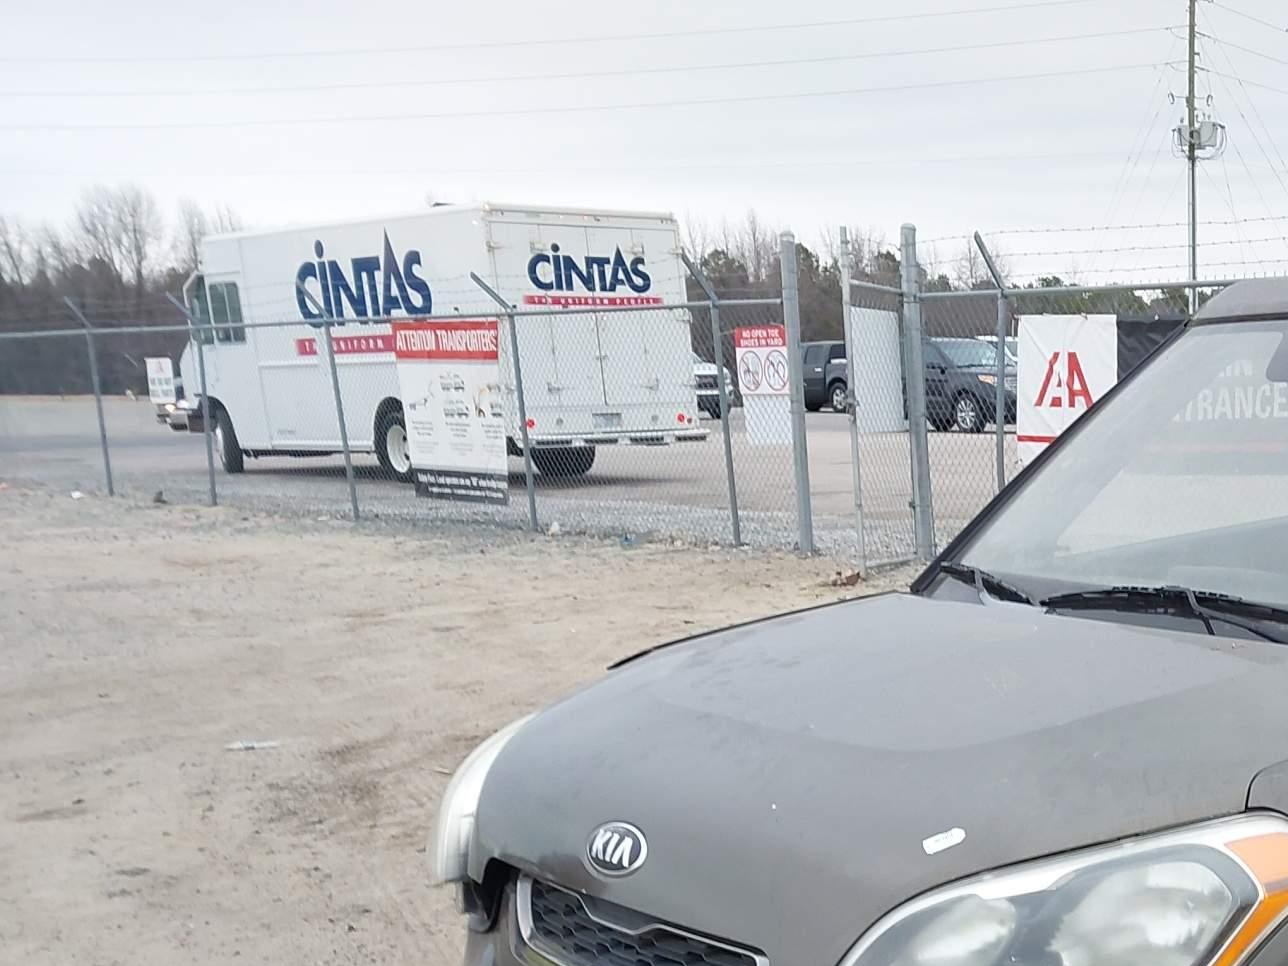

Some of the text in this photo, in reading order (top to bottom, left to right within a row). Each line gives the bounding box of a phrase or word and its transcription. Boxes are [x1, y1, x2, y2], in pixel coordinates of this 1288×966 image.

[296, 227, 432, 328] CINTAS
[527, 243, 651, 293] CINTAS
[591, 829, 634, 868] KIA
